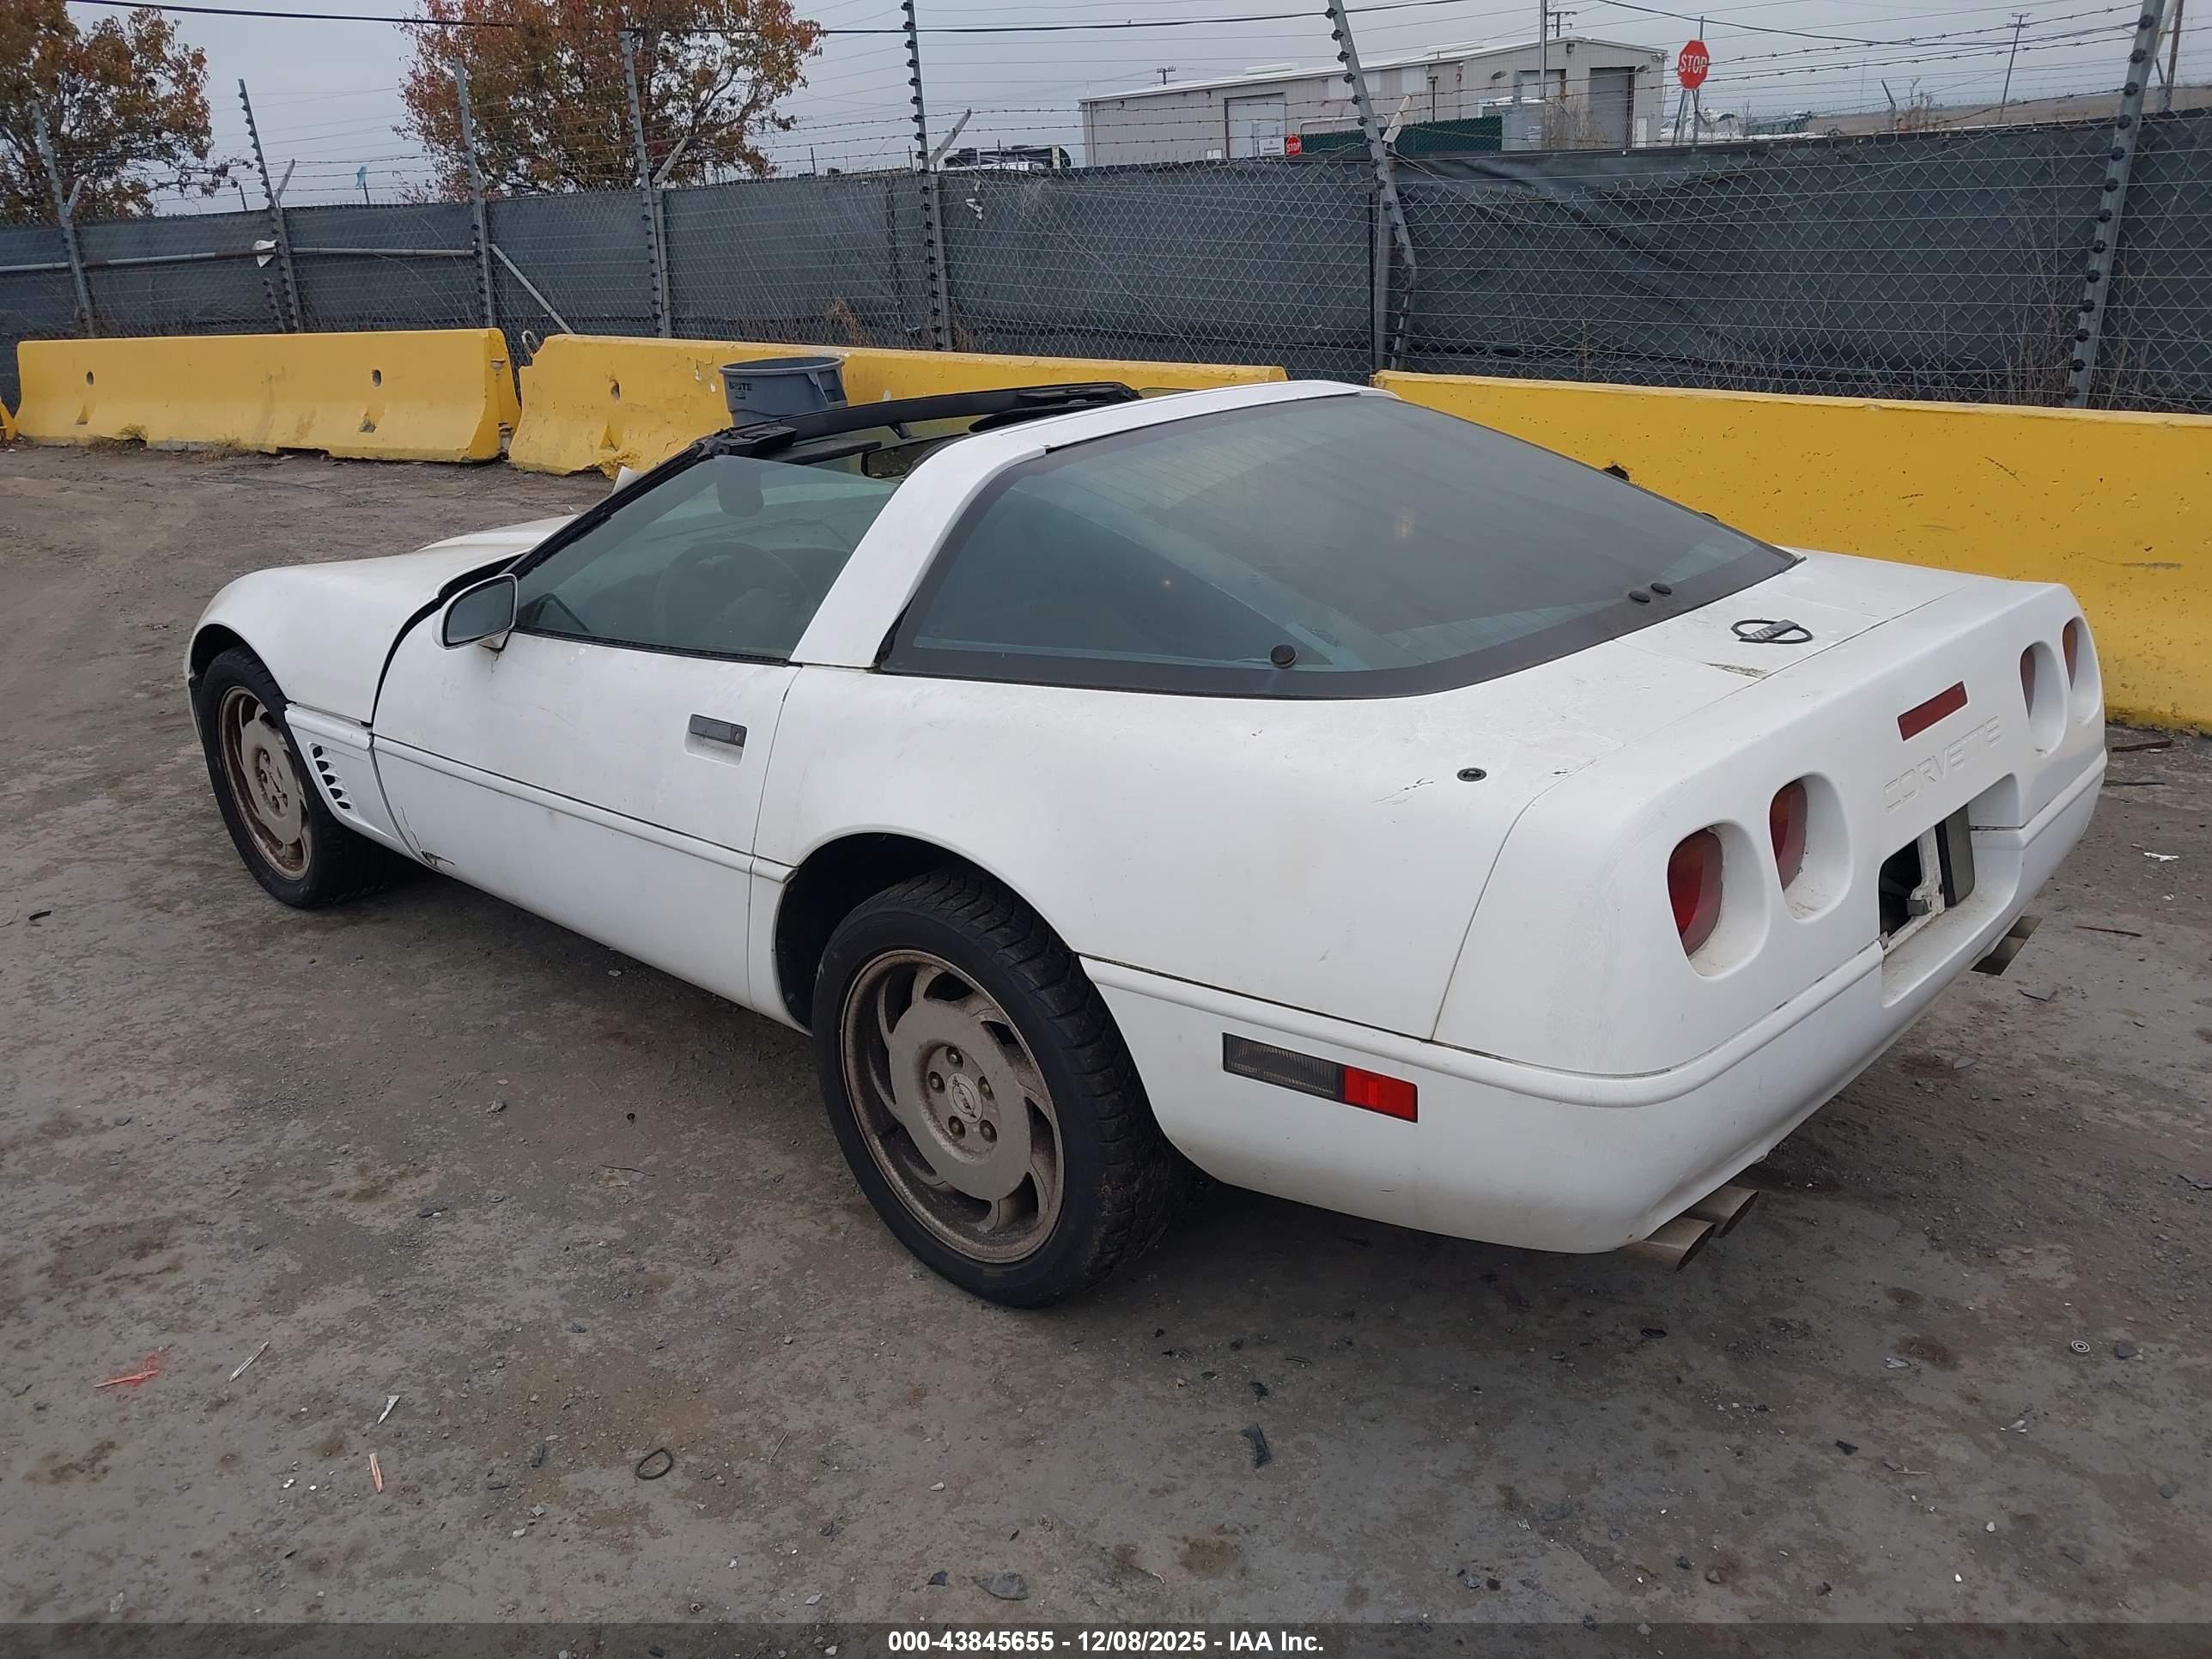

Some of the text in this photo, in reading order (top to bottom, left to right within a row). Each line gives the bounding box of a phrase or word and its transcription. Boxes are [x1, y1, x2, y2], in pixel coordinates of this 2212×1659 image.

[1680, 54, 1708, 74] STOP
[1286, 142, 1300, 153] STOP
[1883, 715, 2002, 811] CORVETTE
